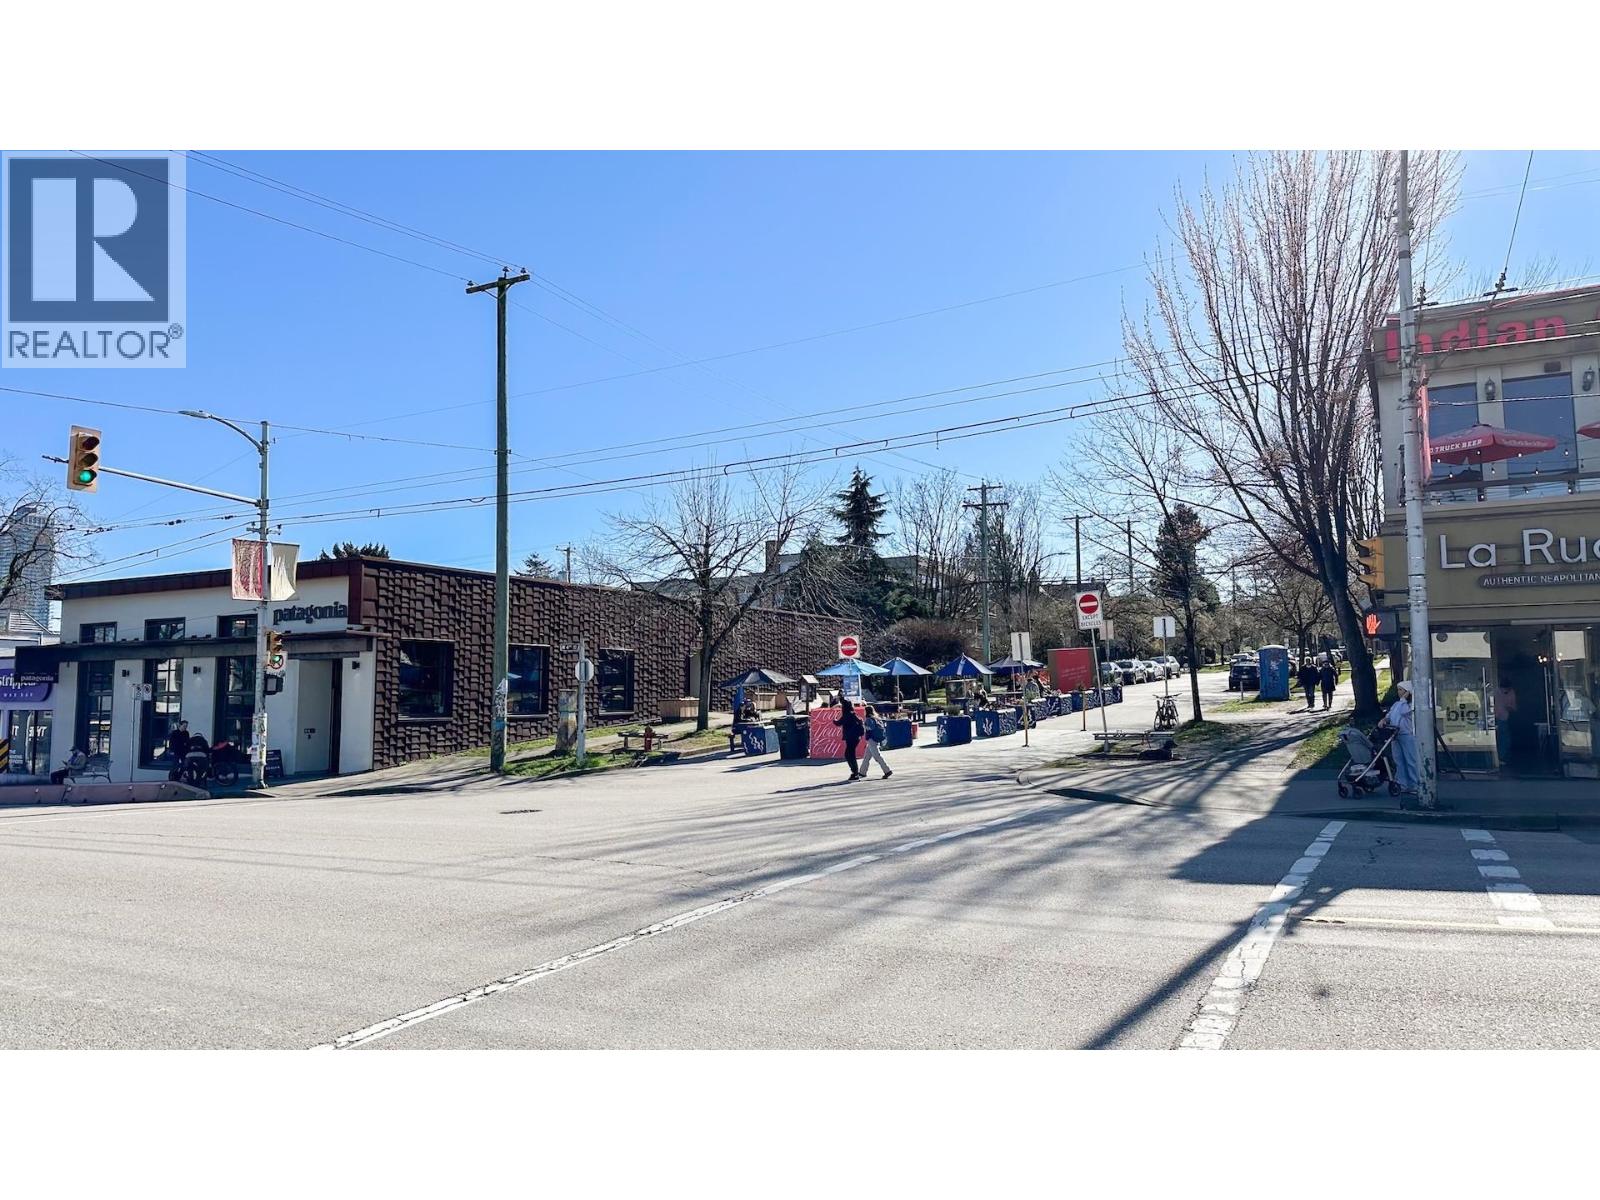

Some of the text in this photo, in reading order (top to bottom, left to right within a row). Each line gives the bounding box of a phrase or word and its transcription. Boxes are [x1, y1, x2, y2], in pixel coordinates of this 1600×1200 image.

[1385, 316, 1567, 362] Indian
[1434, 443, 1461, 453] TRUCK
[1462, 438, 1482, 448] BEER
[1439, 528, 1600, 569] La Ru
[1483, 572, 1600, 586] AUTHENTIC NEAPOLITAN
[273, 601, 348, 625] patagonia
[1446, 703, 1479, 725] big
